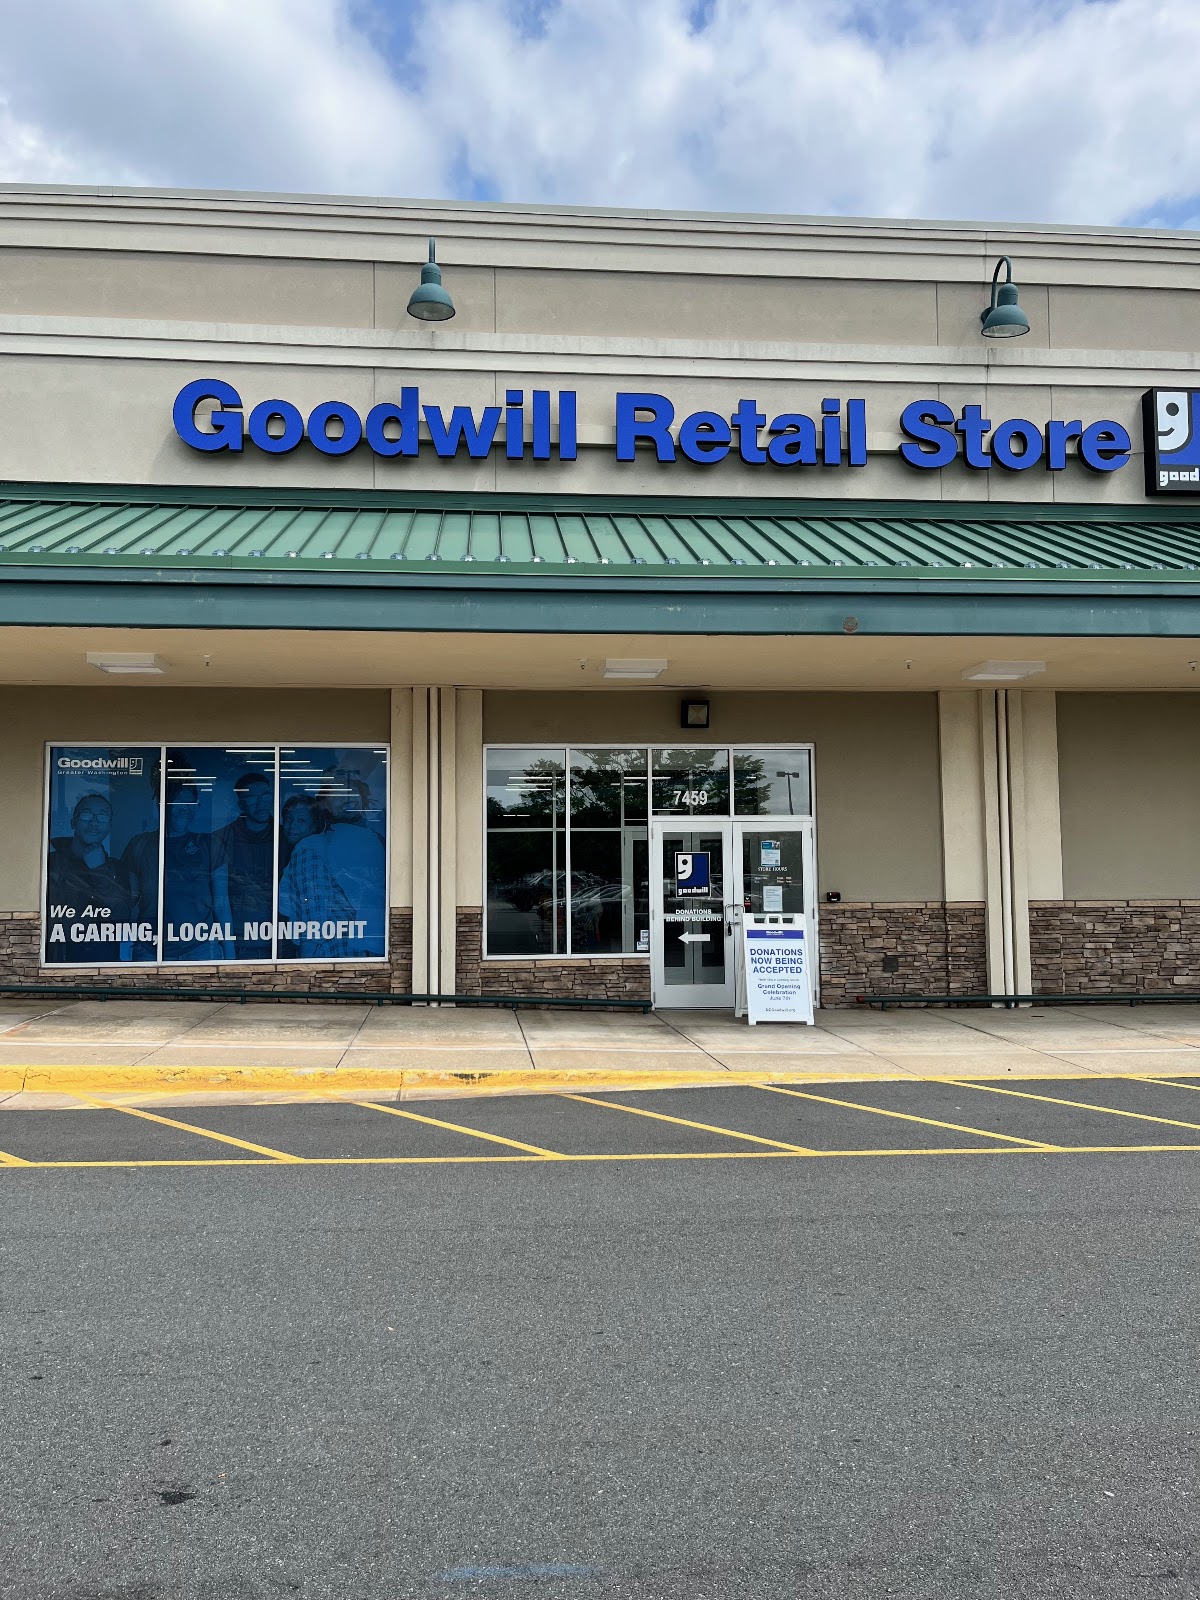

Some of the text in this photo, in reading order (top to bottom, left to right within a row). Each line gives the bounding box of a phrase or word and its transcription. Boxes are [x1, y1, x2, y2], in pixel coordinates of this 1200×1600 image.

[173, 378, 1132, 471] Goodwill Retail Store
[57, 757, 129, 768] Goodwill
[673, 790, 708, 806] 7459
[677, 886, 709, 896] goodwill
[50, 904, 112, 918] We Are
[49, 920, 368, 945] A CARING, LOCAL NONPROFIT
[750, 948, 803, 956] DONATIONS
[750, 957, 803, 965] NOW BEING
[753, 966, 803, 974] ACCEPTED
